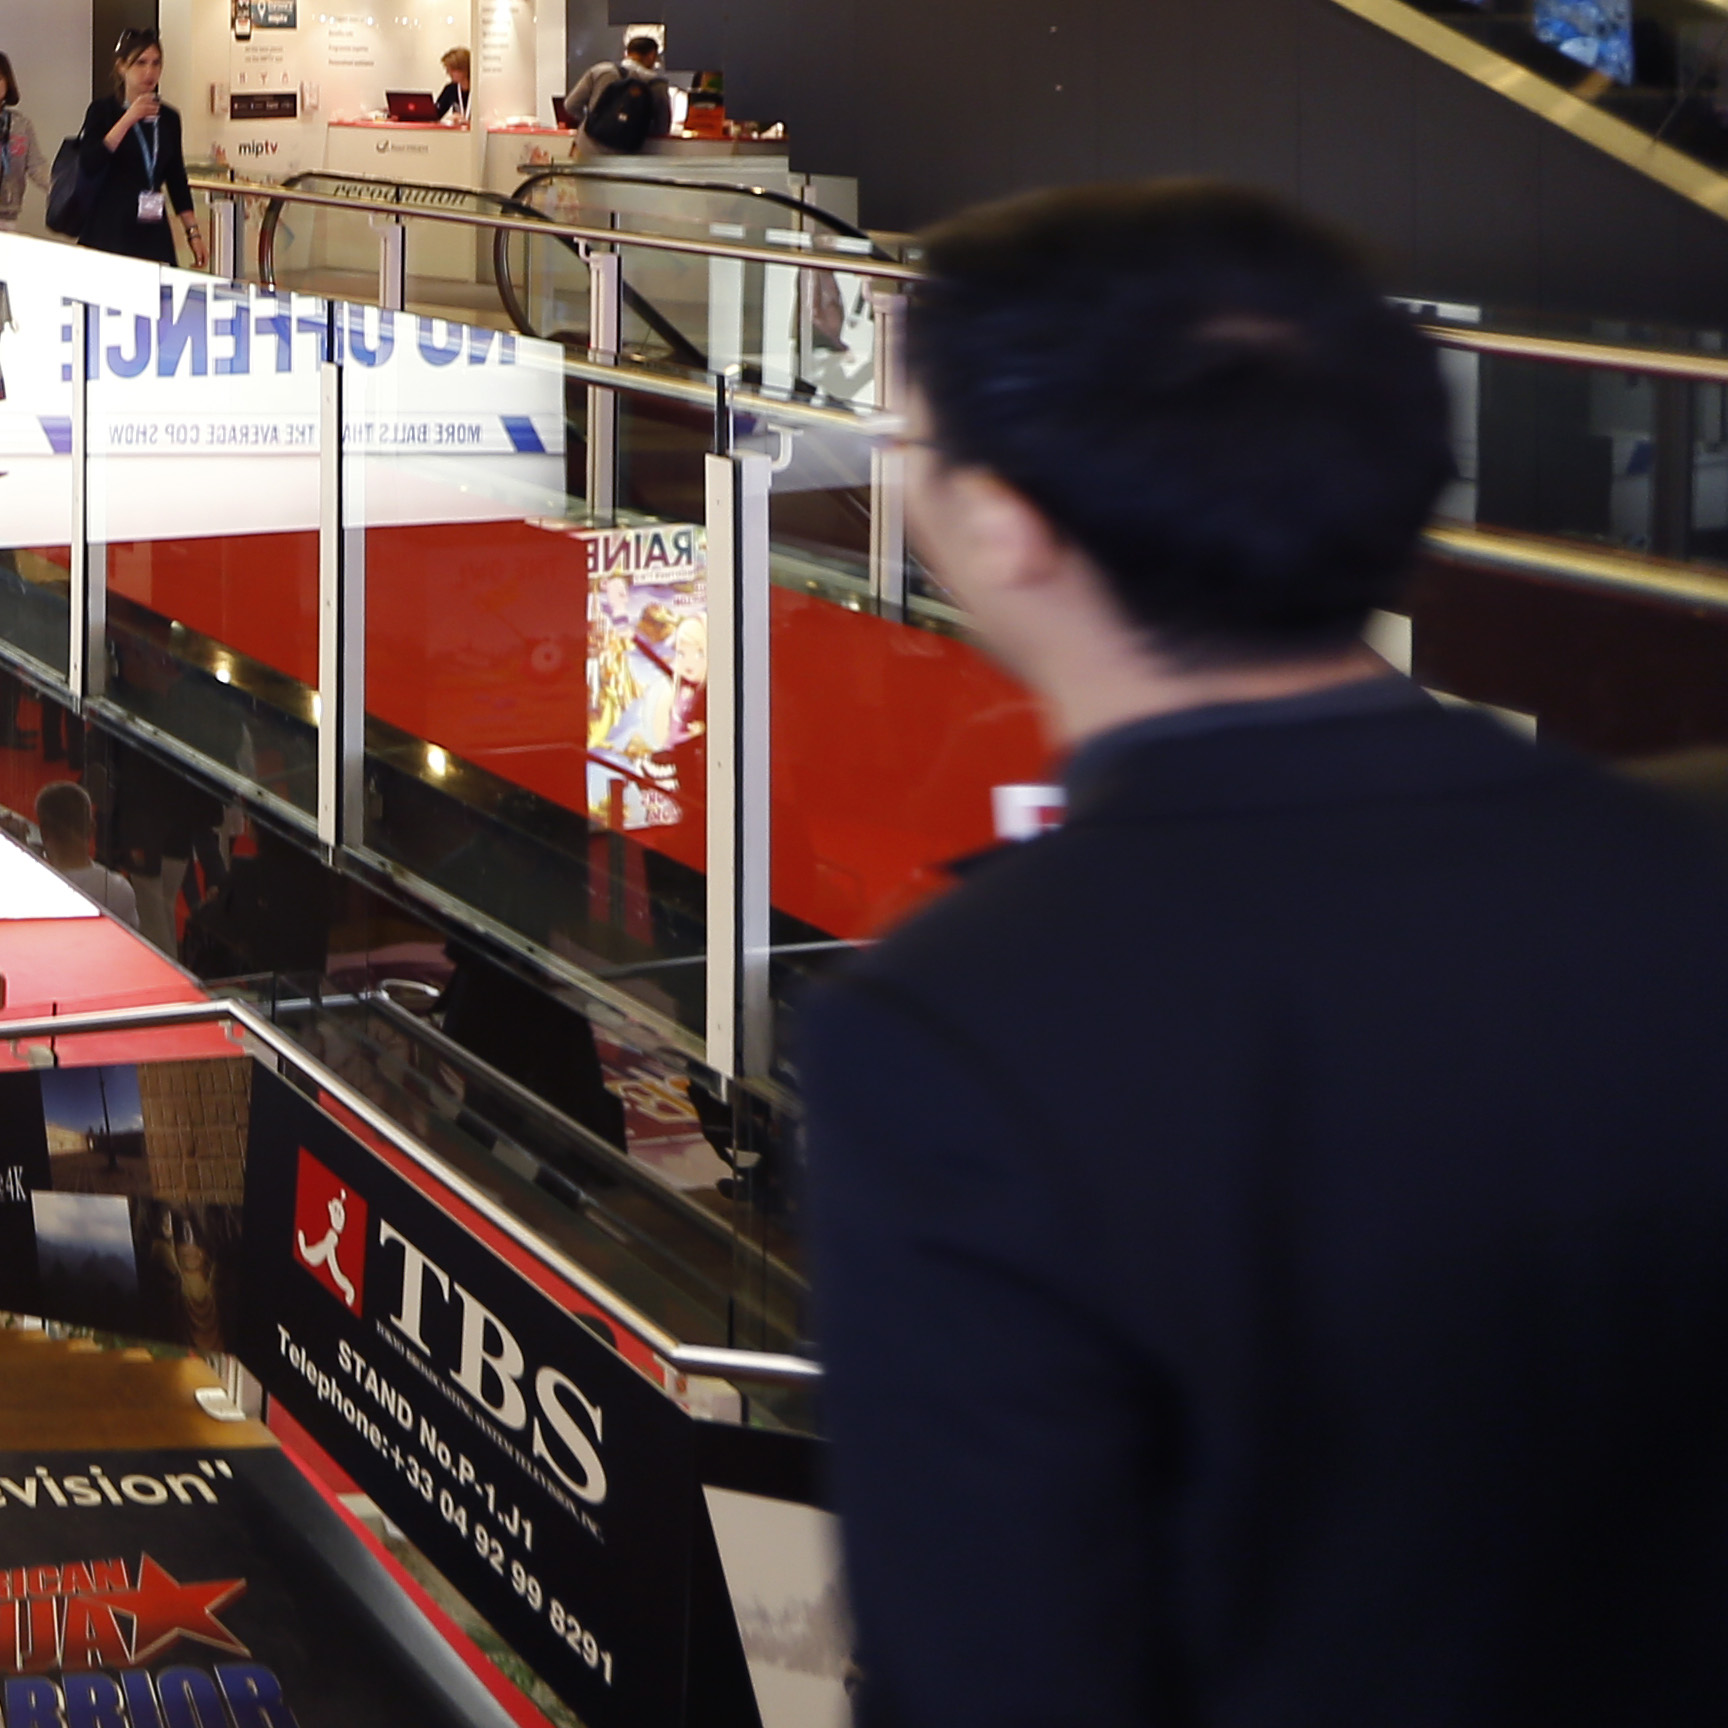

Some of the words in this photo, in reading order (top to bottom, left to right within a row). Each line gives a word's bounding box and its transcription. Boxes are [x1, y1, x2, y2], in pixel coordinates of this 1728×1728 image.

[238, 139, 278, 158] miptv
[5, 1165, 27, 1202] 4K
[337, 1339, 414, 1431] STAND
[419, 1415, 534, 1553] No.P-1.J1
[378, 1218, 608, 1505] TBS
[439, 1488, 469, 1539] 04
[474, 1523, 505, 1577] 92
[510, 1559, 543, 1612] 99
[548, 1597, 614, 1686] 8291
